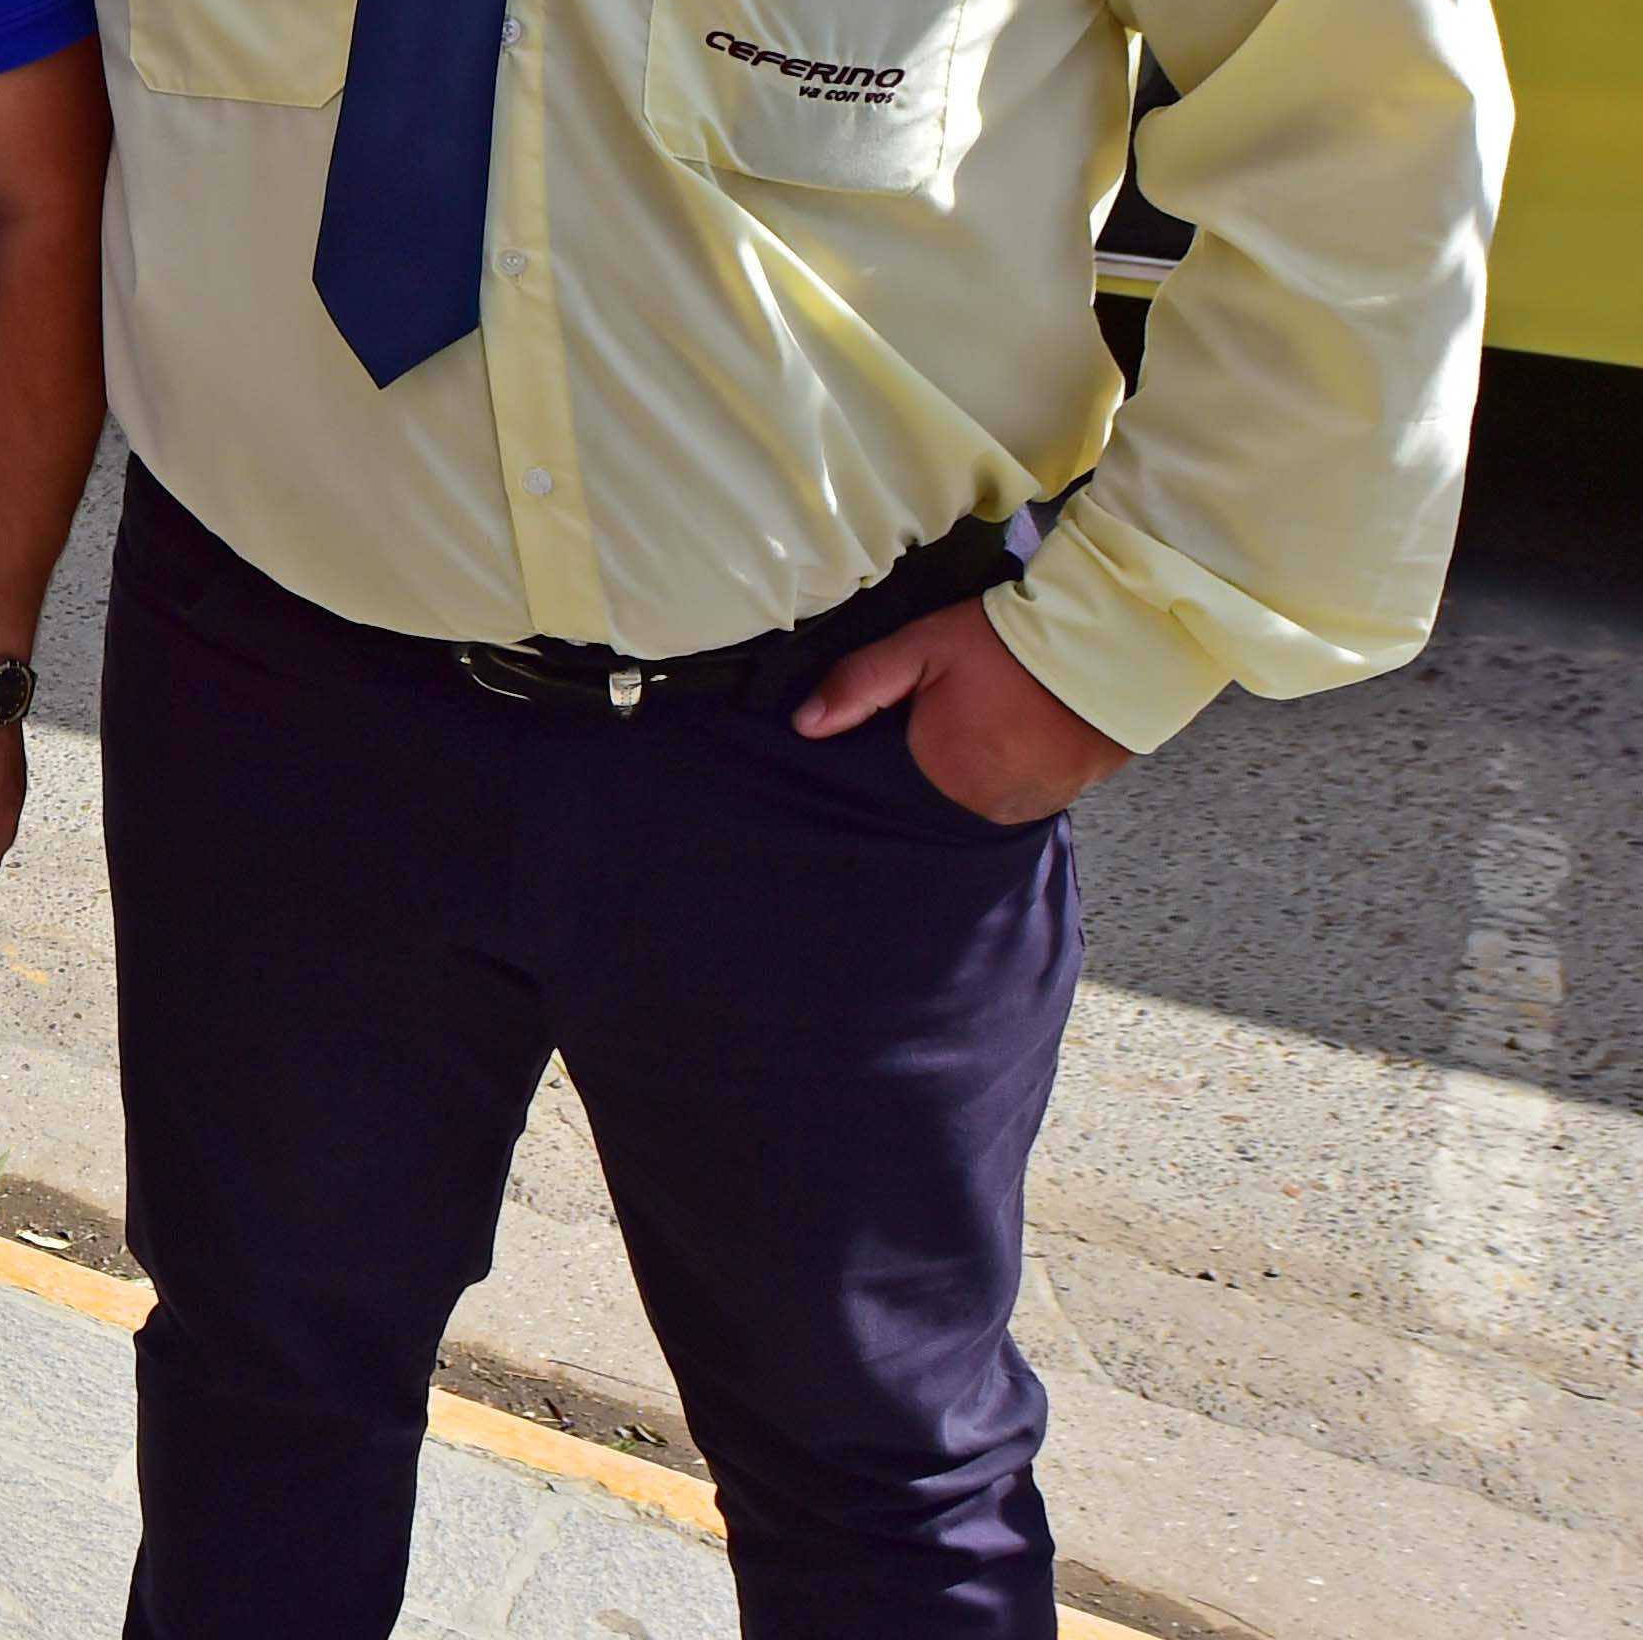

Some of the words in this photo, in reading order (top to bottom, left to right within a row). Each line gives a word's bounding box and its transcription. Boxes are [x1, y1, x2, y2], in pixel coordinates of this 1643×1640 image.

[705, 30, 905, 89] CEFERINO
[799, 85, 822, 99] va
[825, 89, 860, 102] con
[864, 92, 895, 104] vos
